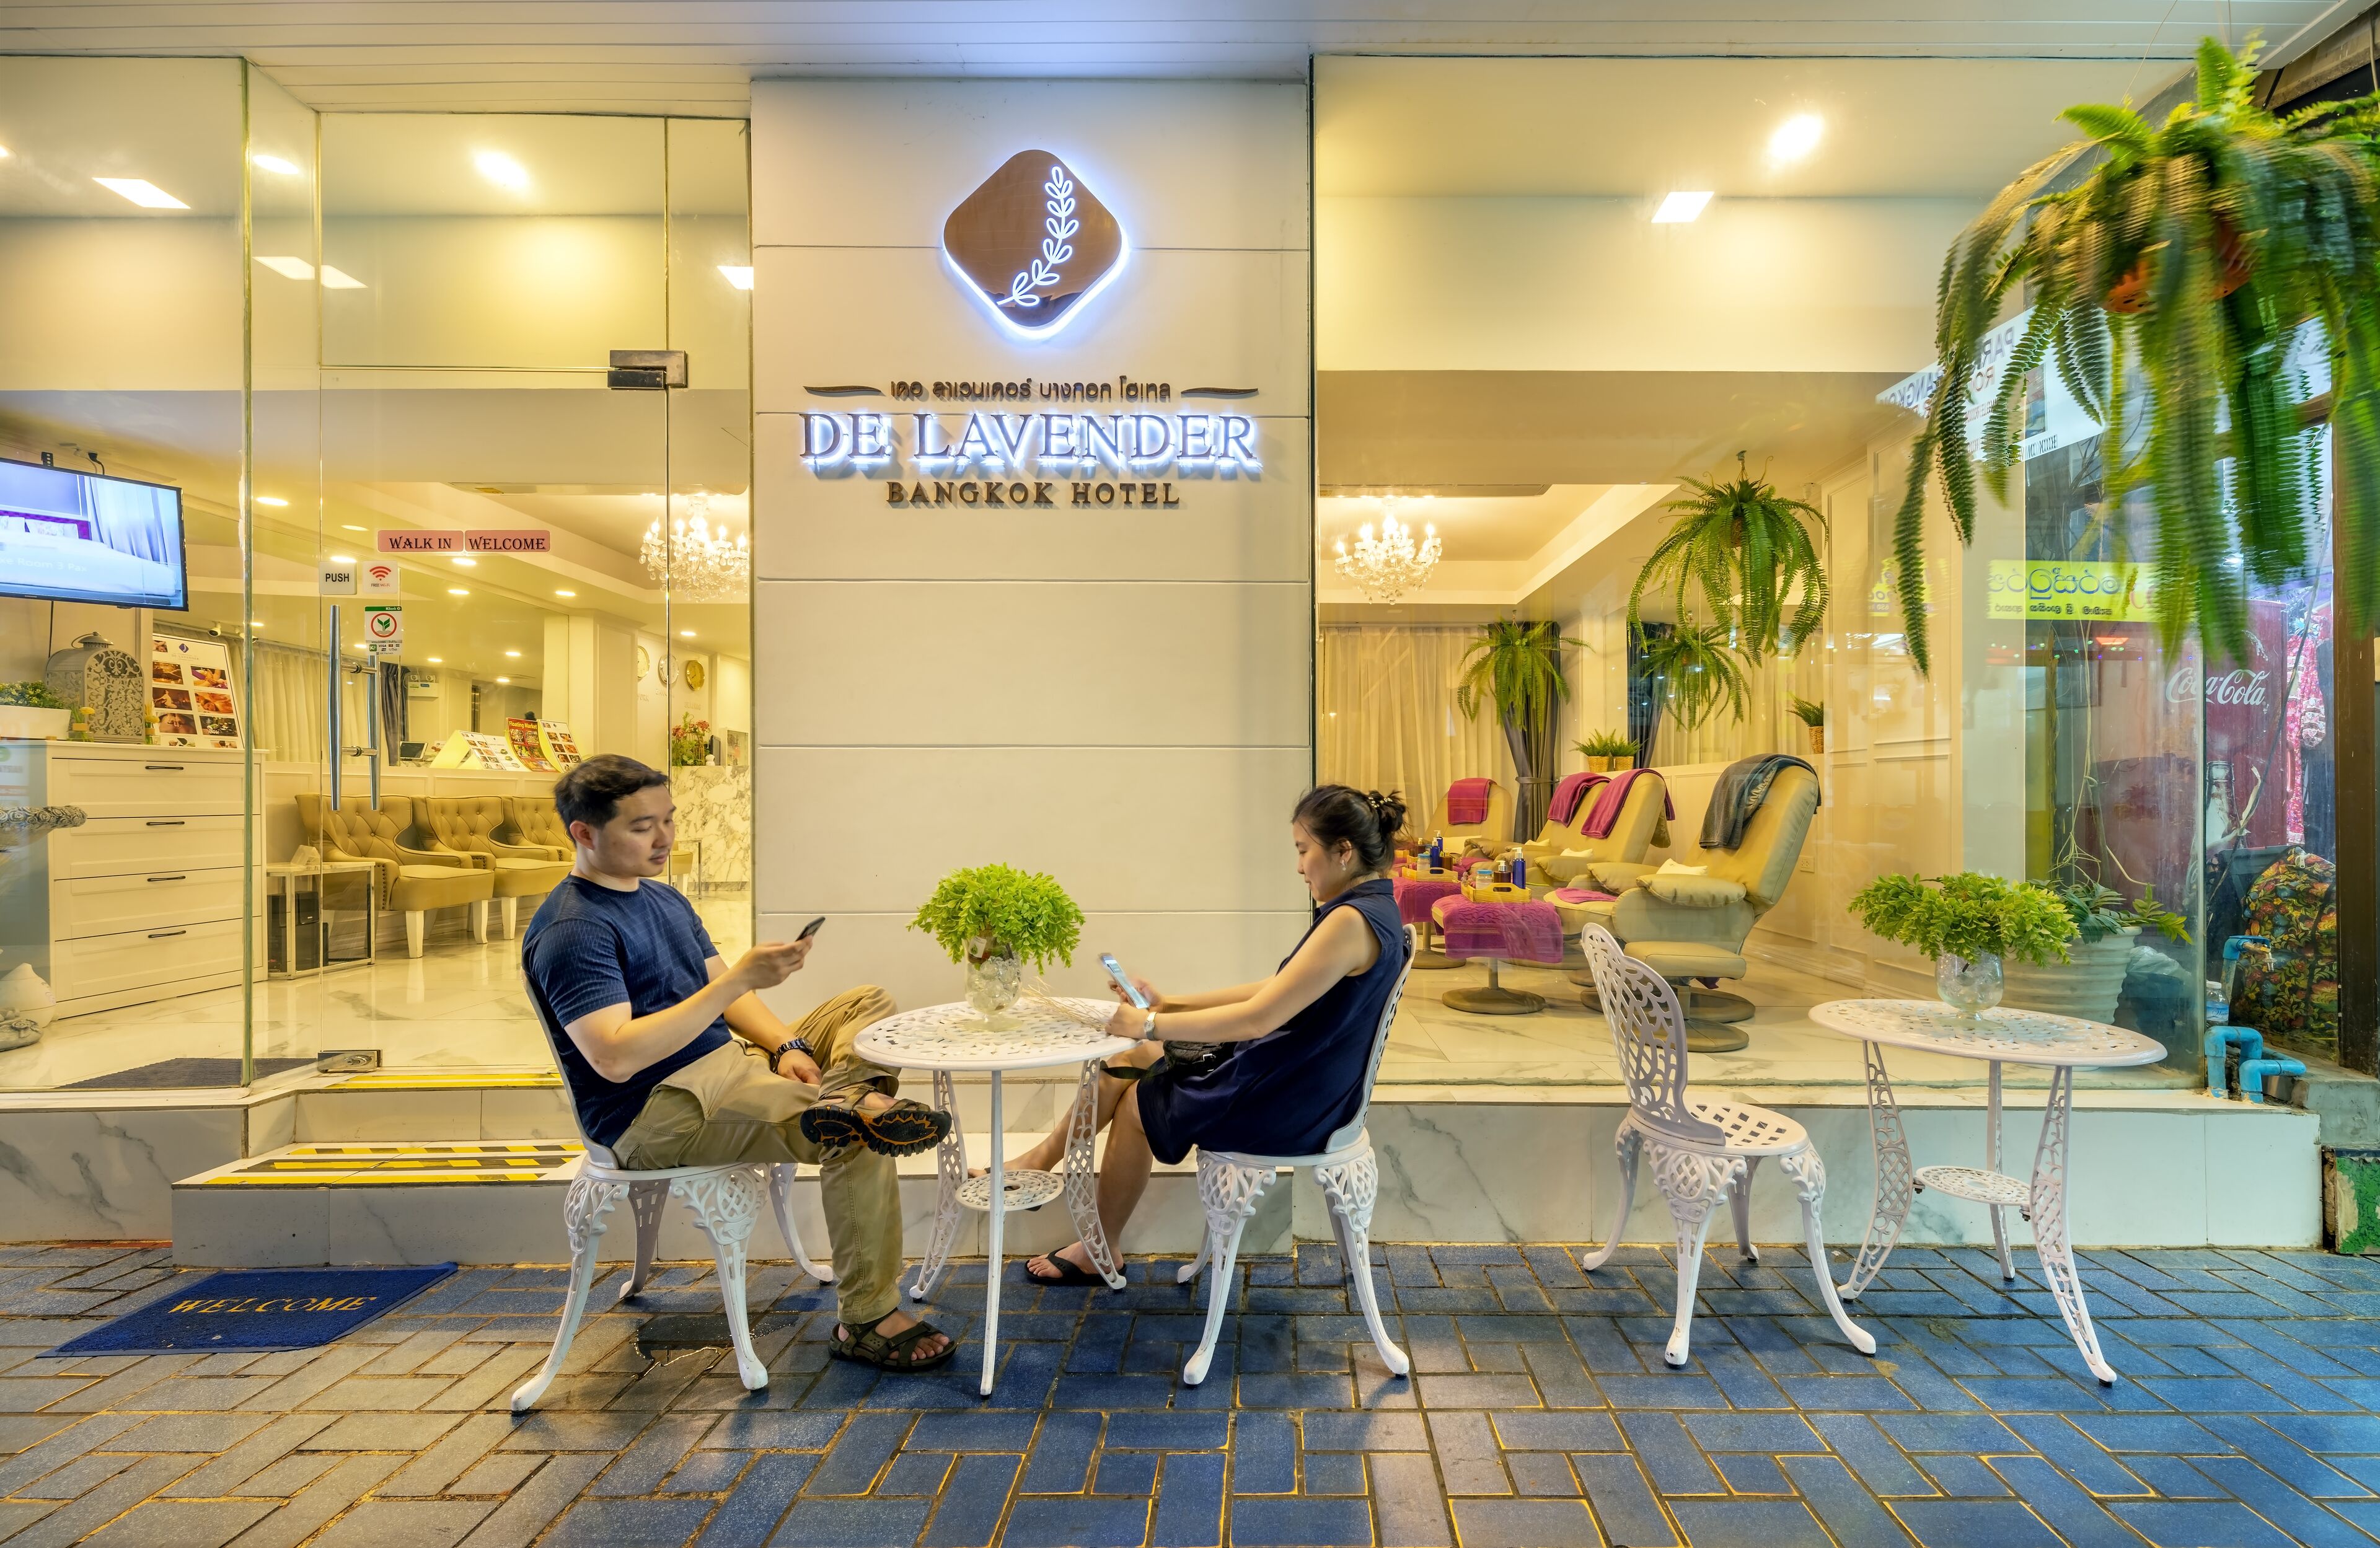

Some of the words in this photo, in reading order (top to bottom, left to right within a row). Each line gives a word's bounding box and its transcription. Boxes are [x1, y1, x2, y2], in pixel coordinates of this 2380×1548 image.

[1039, 381, 1111, 398] บางกอก
[1119, 375, 1171, 398] โฮเทล
[800, 413, 888, 459] DE
[913, 413, 1258, 461] LAVENDER
[887, 481, 1052, 503] BANGKOK
[1072, 482, 1180, 504] HOTEL
[389, 535, 433, 549] WALK
[438, 537, 451, 549] IN
[469, 535, 546, 550] WELCOME
[325, 573, 350, 583] PUSH
[509, 721, 524, 729] Floating
[167, 1296, 378, 1314] WELCOME
